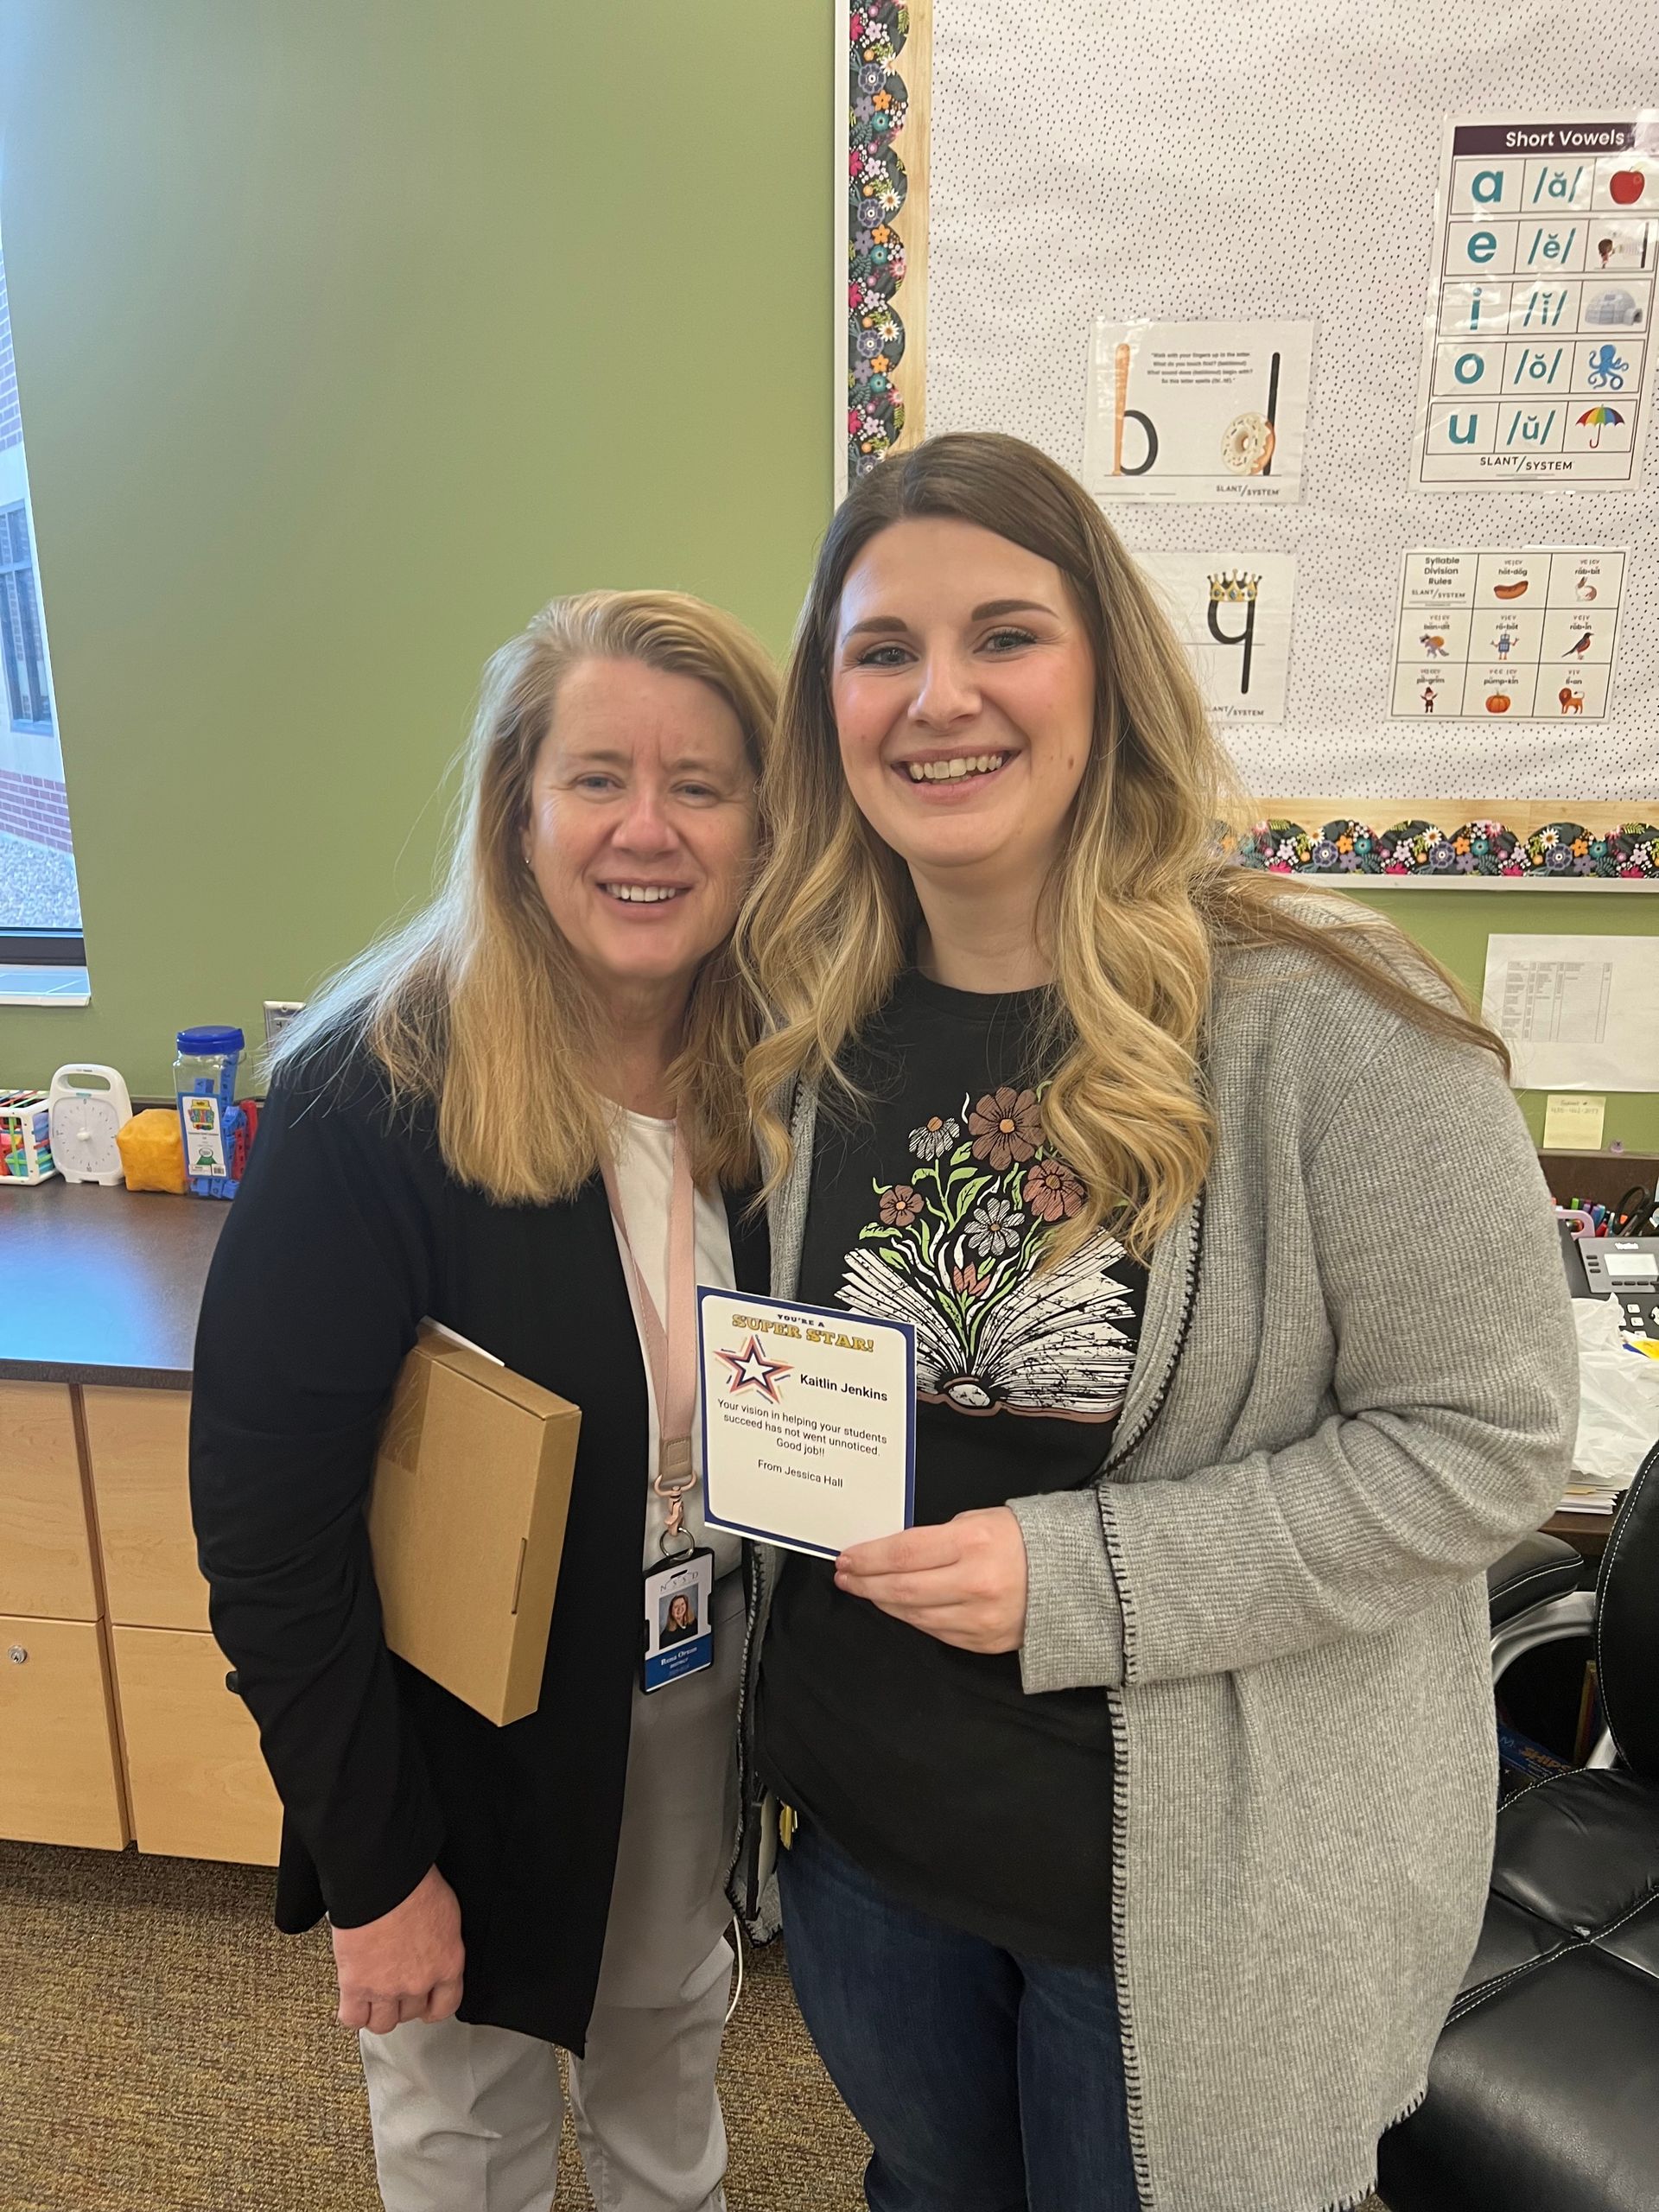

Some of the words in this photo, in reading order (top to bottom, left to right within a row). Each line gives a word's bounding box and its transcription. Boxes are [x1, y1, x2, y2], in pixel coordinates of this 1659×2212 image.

[1505, 130, 1554, 148] Short
[1559, 129, 1625, 146] Vowels
[1471, 169, 1504, 203] a
[1466, 231, 1497, 264] e
[1469, 287, 1482, 330] i
[1454, 353, 1485, 385] o
[1448, 413, 1478, 444] u
[1426, 556, 1460, 567] Syllable
[732, 1313, 802, 1338] SUPER
[806, 1328, 874, 1352] STAR!
[778, 1313, 815, 1325] YOU'RE
[800, 1374, 837, 1391] Kaitlin
[841, 1382, 888, 1402] Jenkins
[717, 1398, 739, 1411] Your
[741, 1404, 769, 1417] vision
[772, 1409, 780, 1420] in
[782, 1412, 817, 1430] helping
[820, 1422, 841, 1434] your
[843, 1427, 887, 1444] students
[724, 1414, 763, 1429] succeed
[765, 1421, 782, 1433] has
[785, 1427, 800, 1438] not
[803, 1433, 827, 1444] went
[829, 1436, 880, 1456] unnoticed.
[776, 1438, 802, 1452] Good
[804, 1445, 825, 1457] job!!
[758, 1459, 782, 1473] From
[785, 1465, 821, 1483] Jessica
[823, 1475, 843, 1488] Hall
